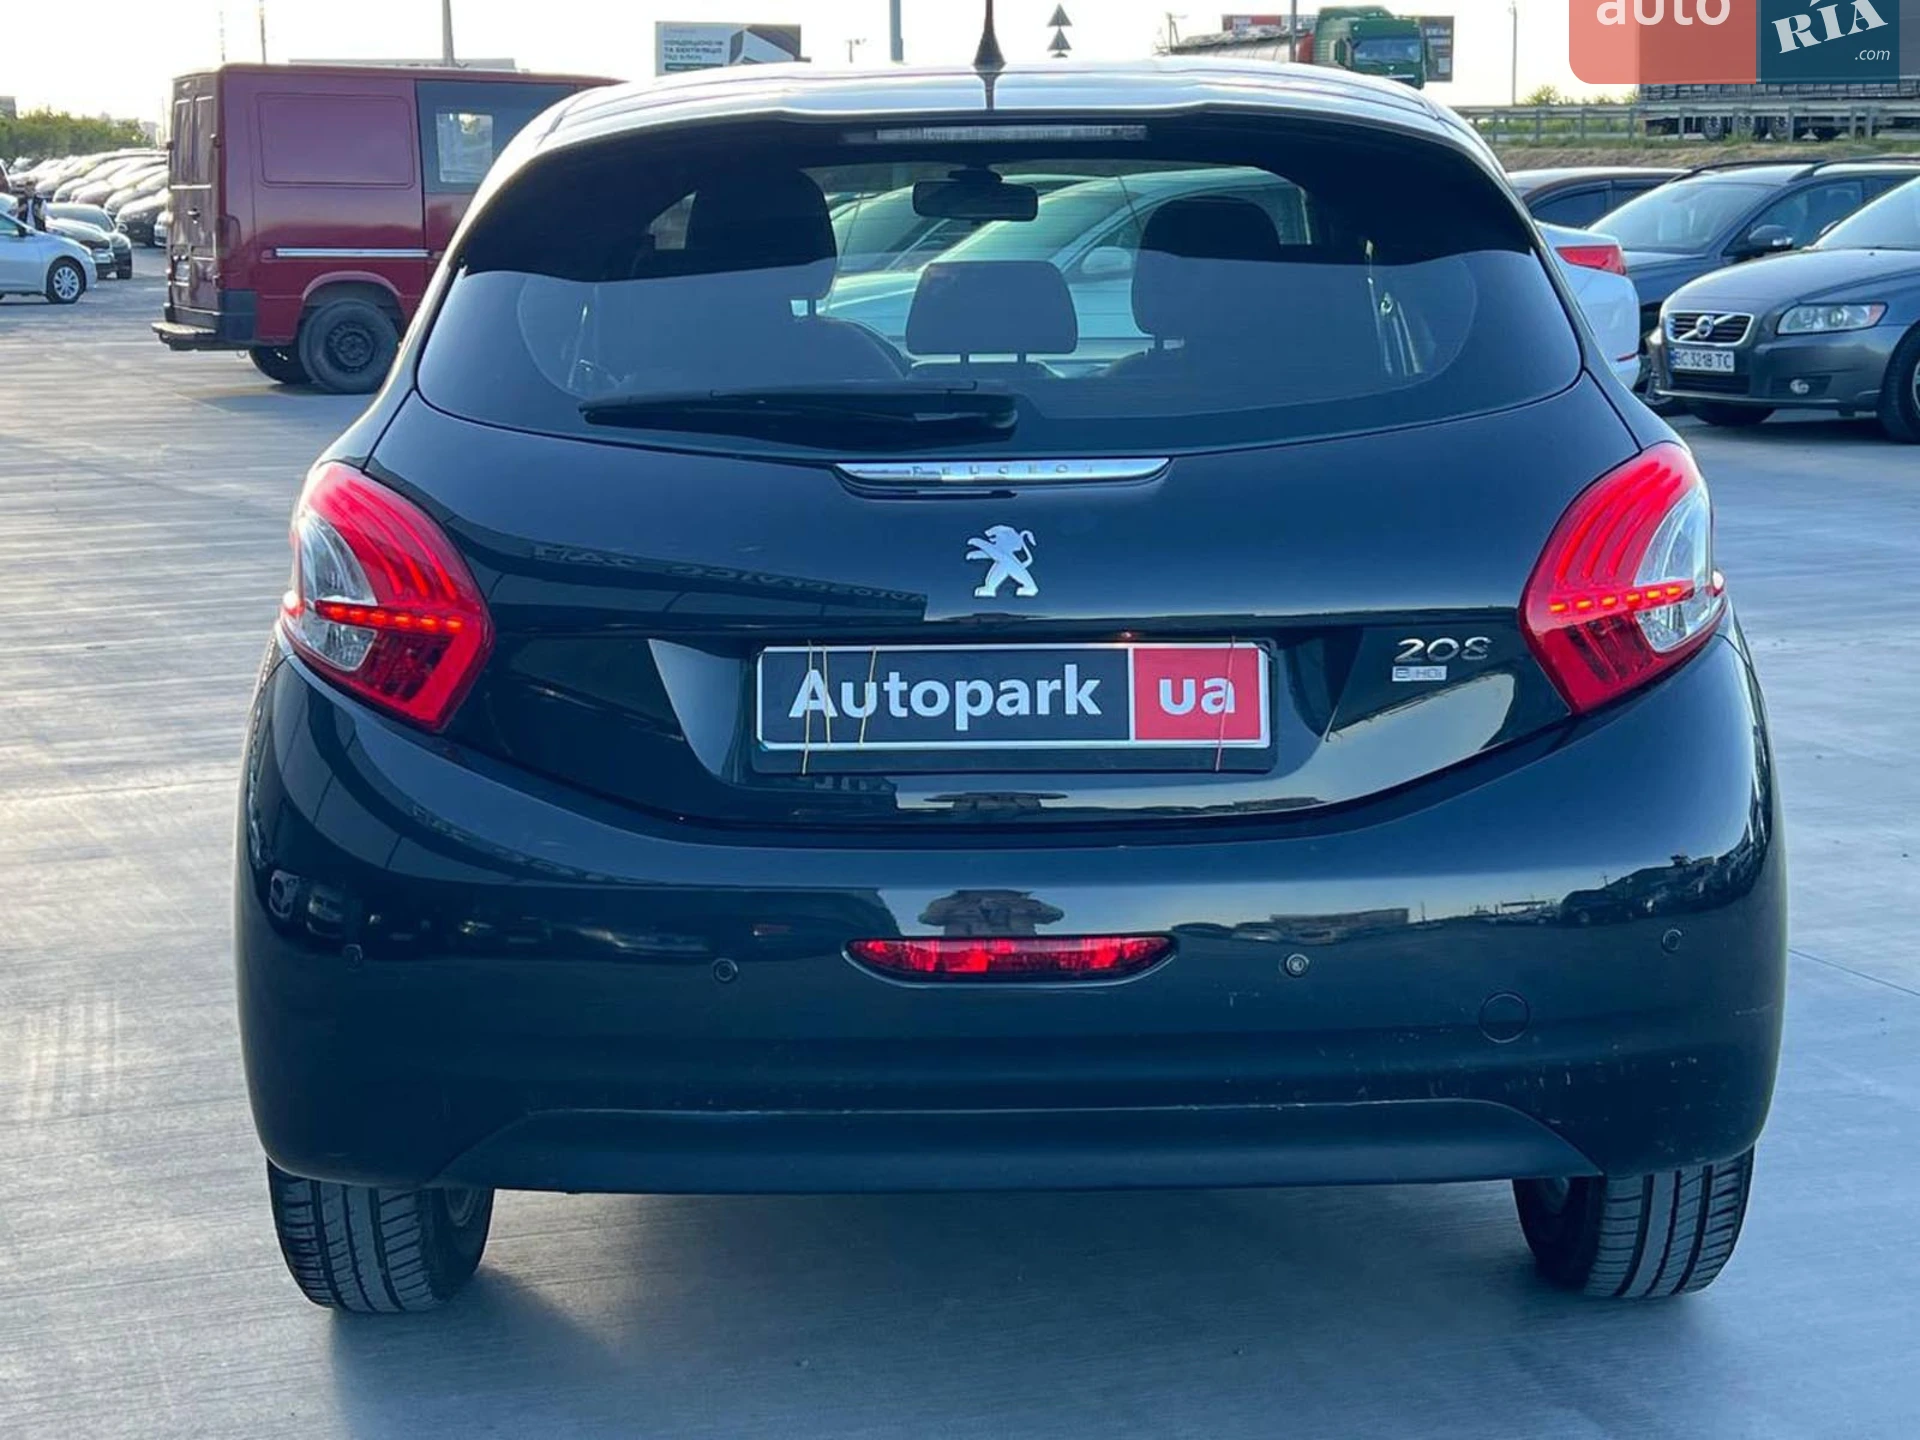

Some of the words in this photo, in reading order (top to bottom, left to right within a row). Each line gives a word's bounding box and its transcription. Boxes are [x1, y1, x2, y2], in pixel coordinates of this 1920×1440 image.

[1394, 636, 1493, 663] 208
[788, 663, 1102, 731] Autopark
[1158, 677, 1236, 715] ua
